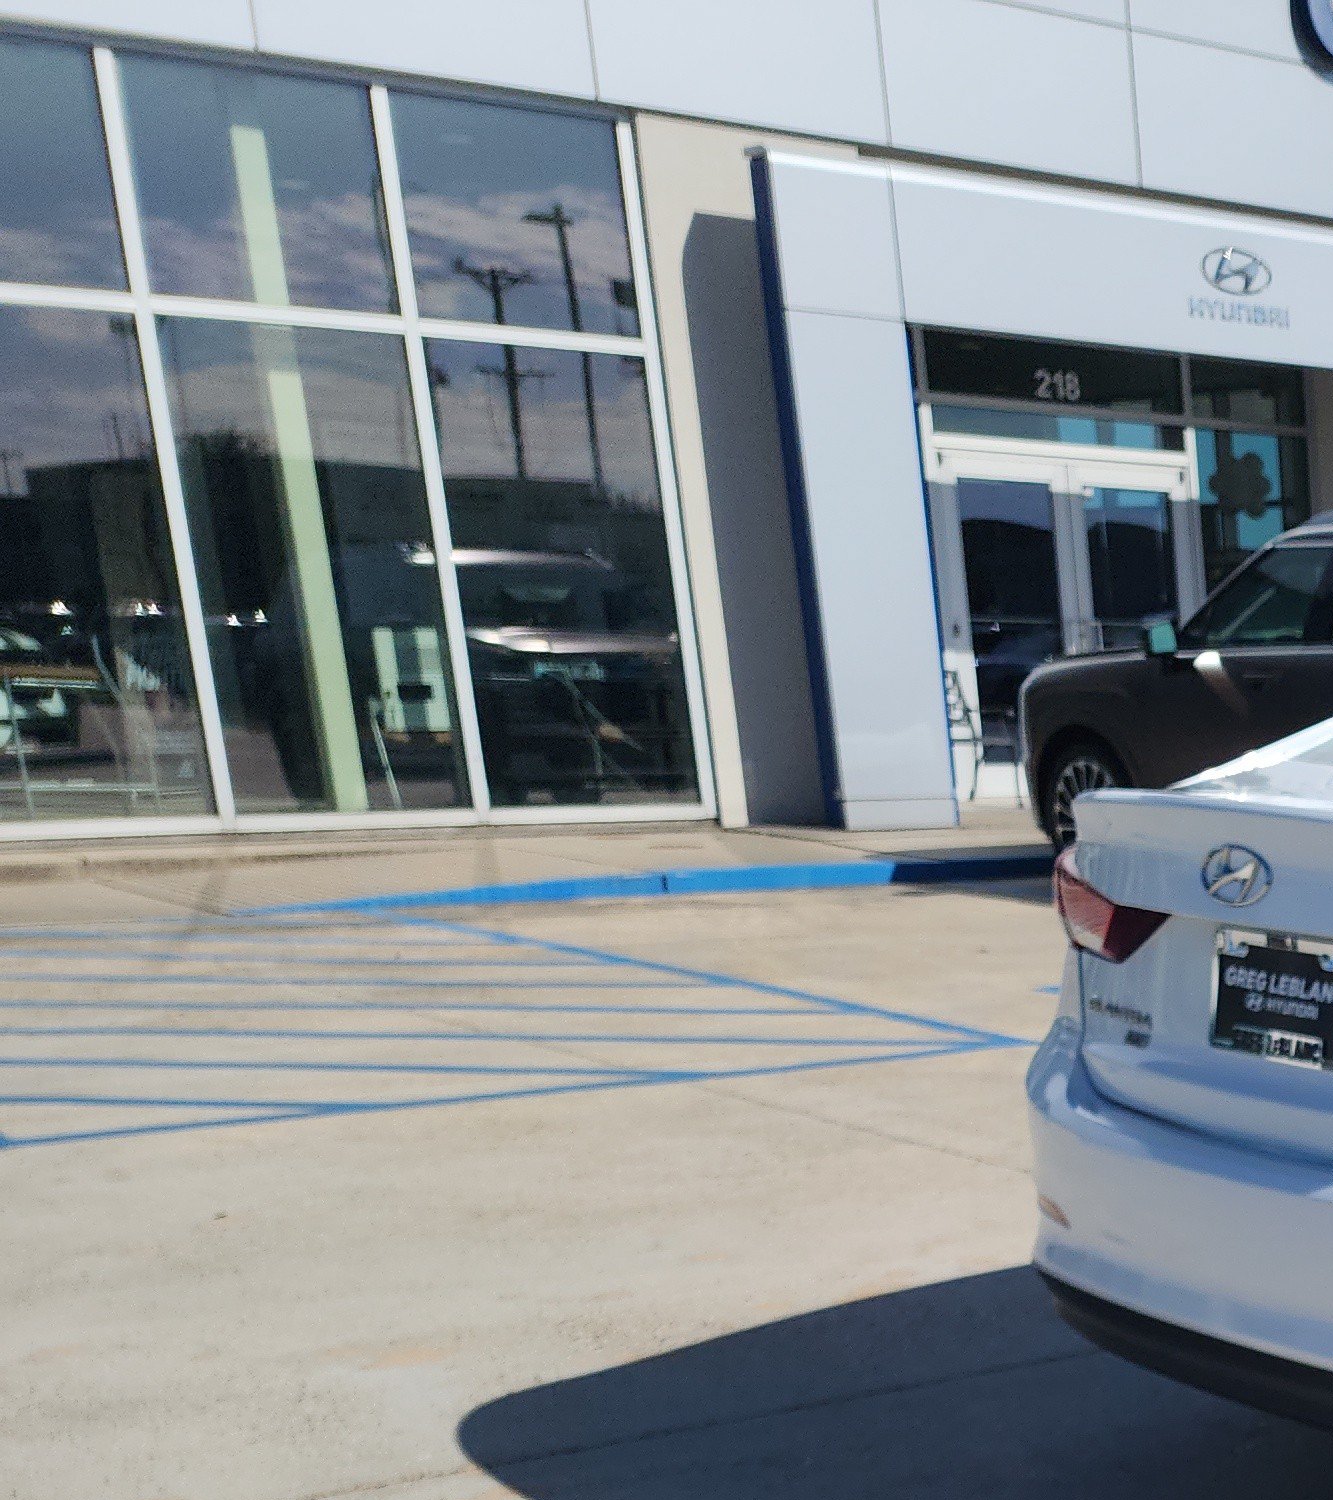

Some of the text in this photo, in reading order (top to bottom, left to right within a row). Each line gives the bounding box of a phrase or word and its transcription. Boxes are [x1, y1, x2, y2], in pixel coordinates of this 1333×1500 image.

[1187, 297, 1290, 330] HYUNDAI
[1033, 368, 1081, 401] 218
[1224, 965, 1268, 993] GREG
